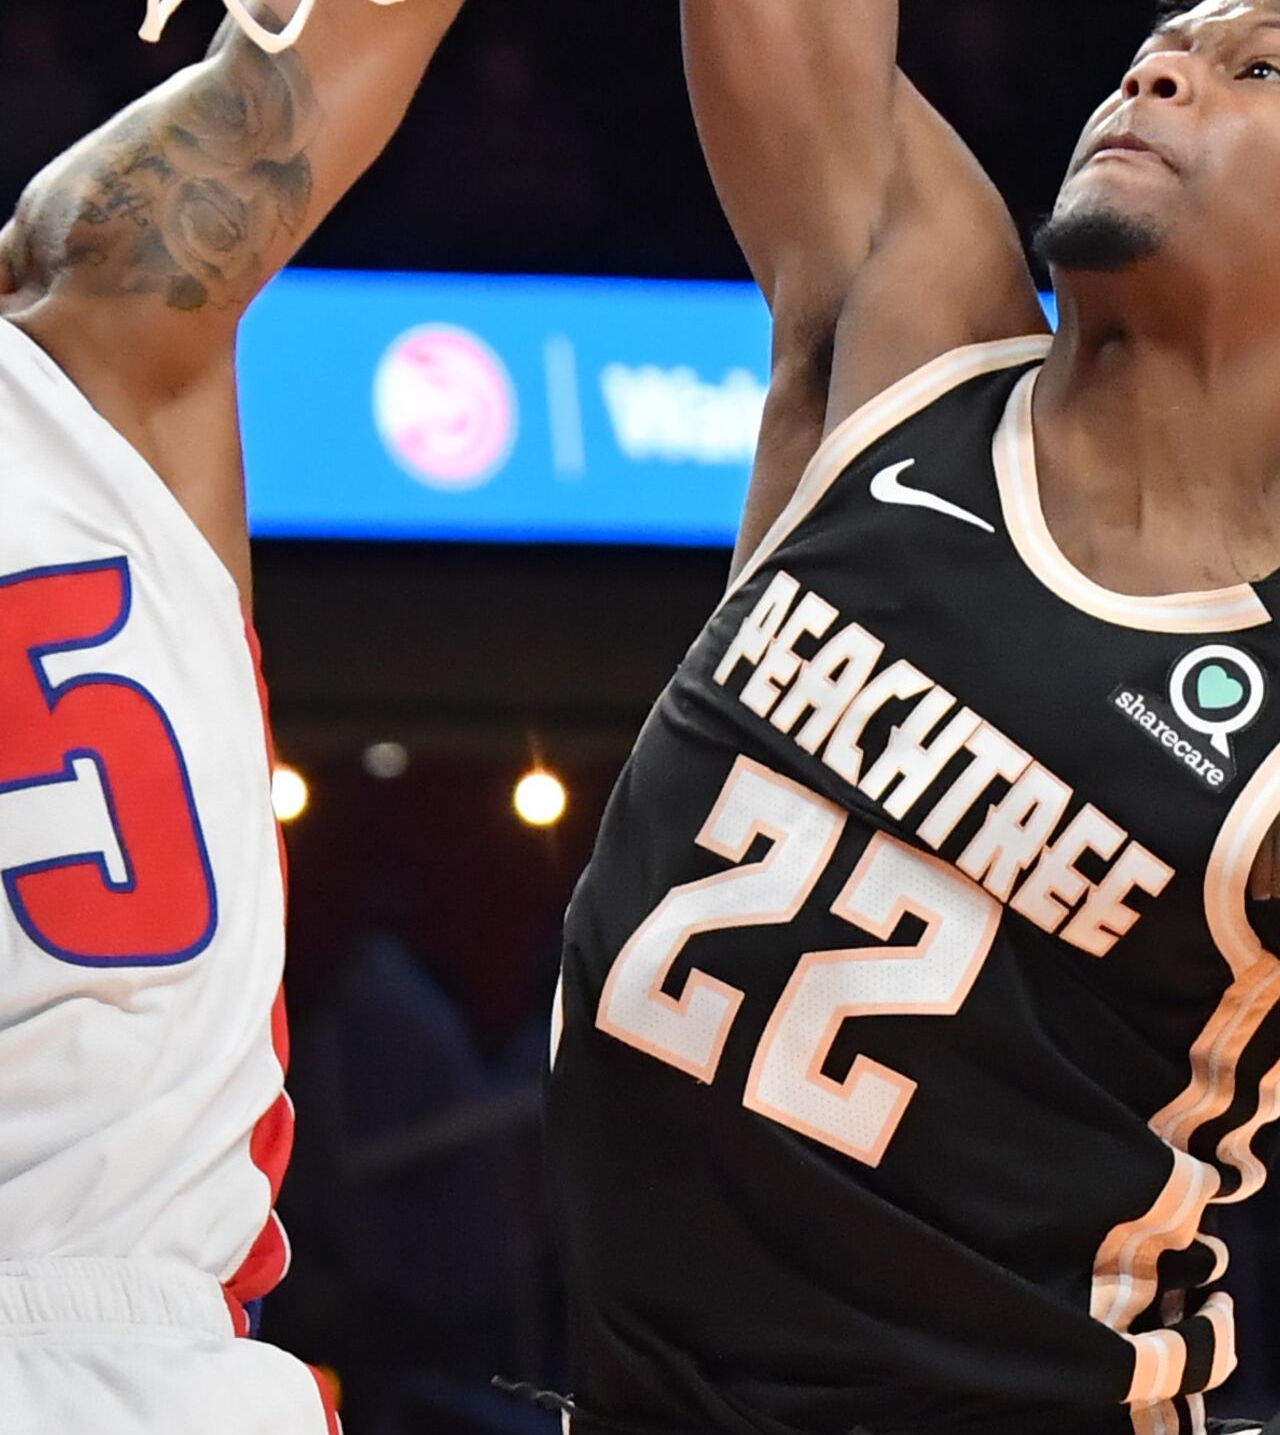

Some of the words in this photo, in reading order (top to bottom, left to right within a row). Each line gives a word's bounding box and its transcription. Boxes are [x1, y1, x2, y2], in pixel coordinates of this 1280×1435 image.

[713, 570, 1176, 957] PEACHTREE
[1115, 690, 1225, 786] sharecare
[595, 754, 1004, 1168] 22
